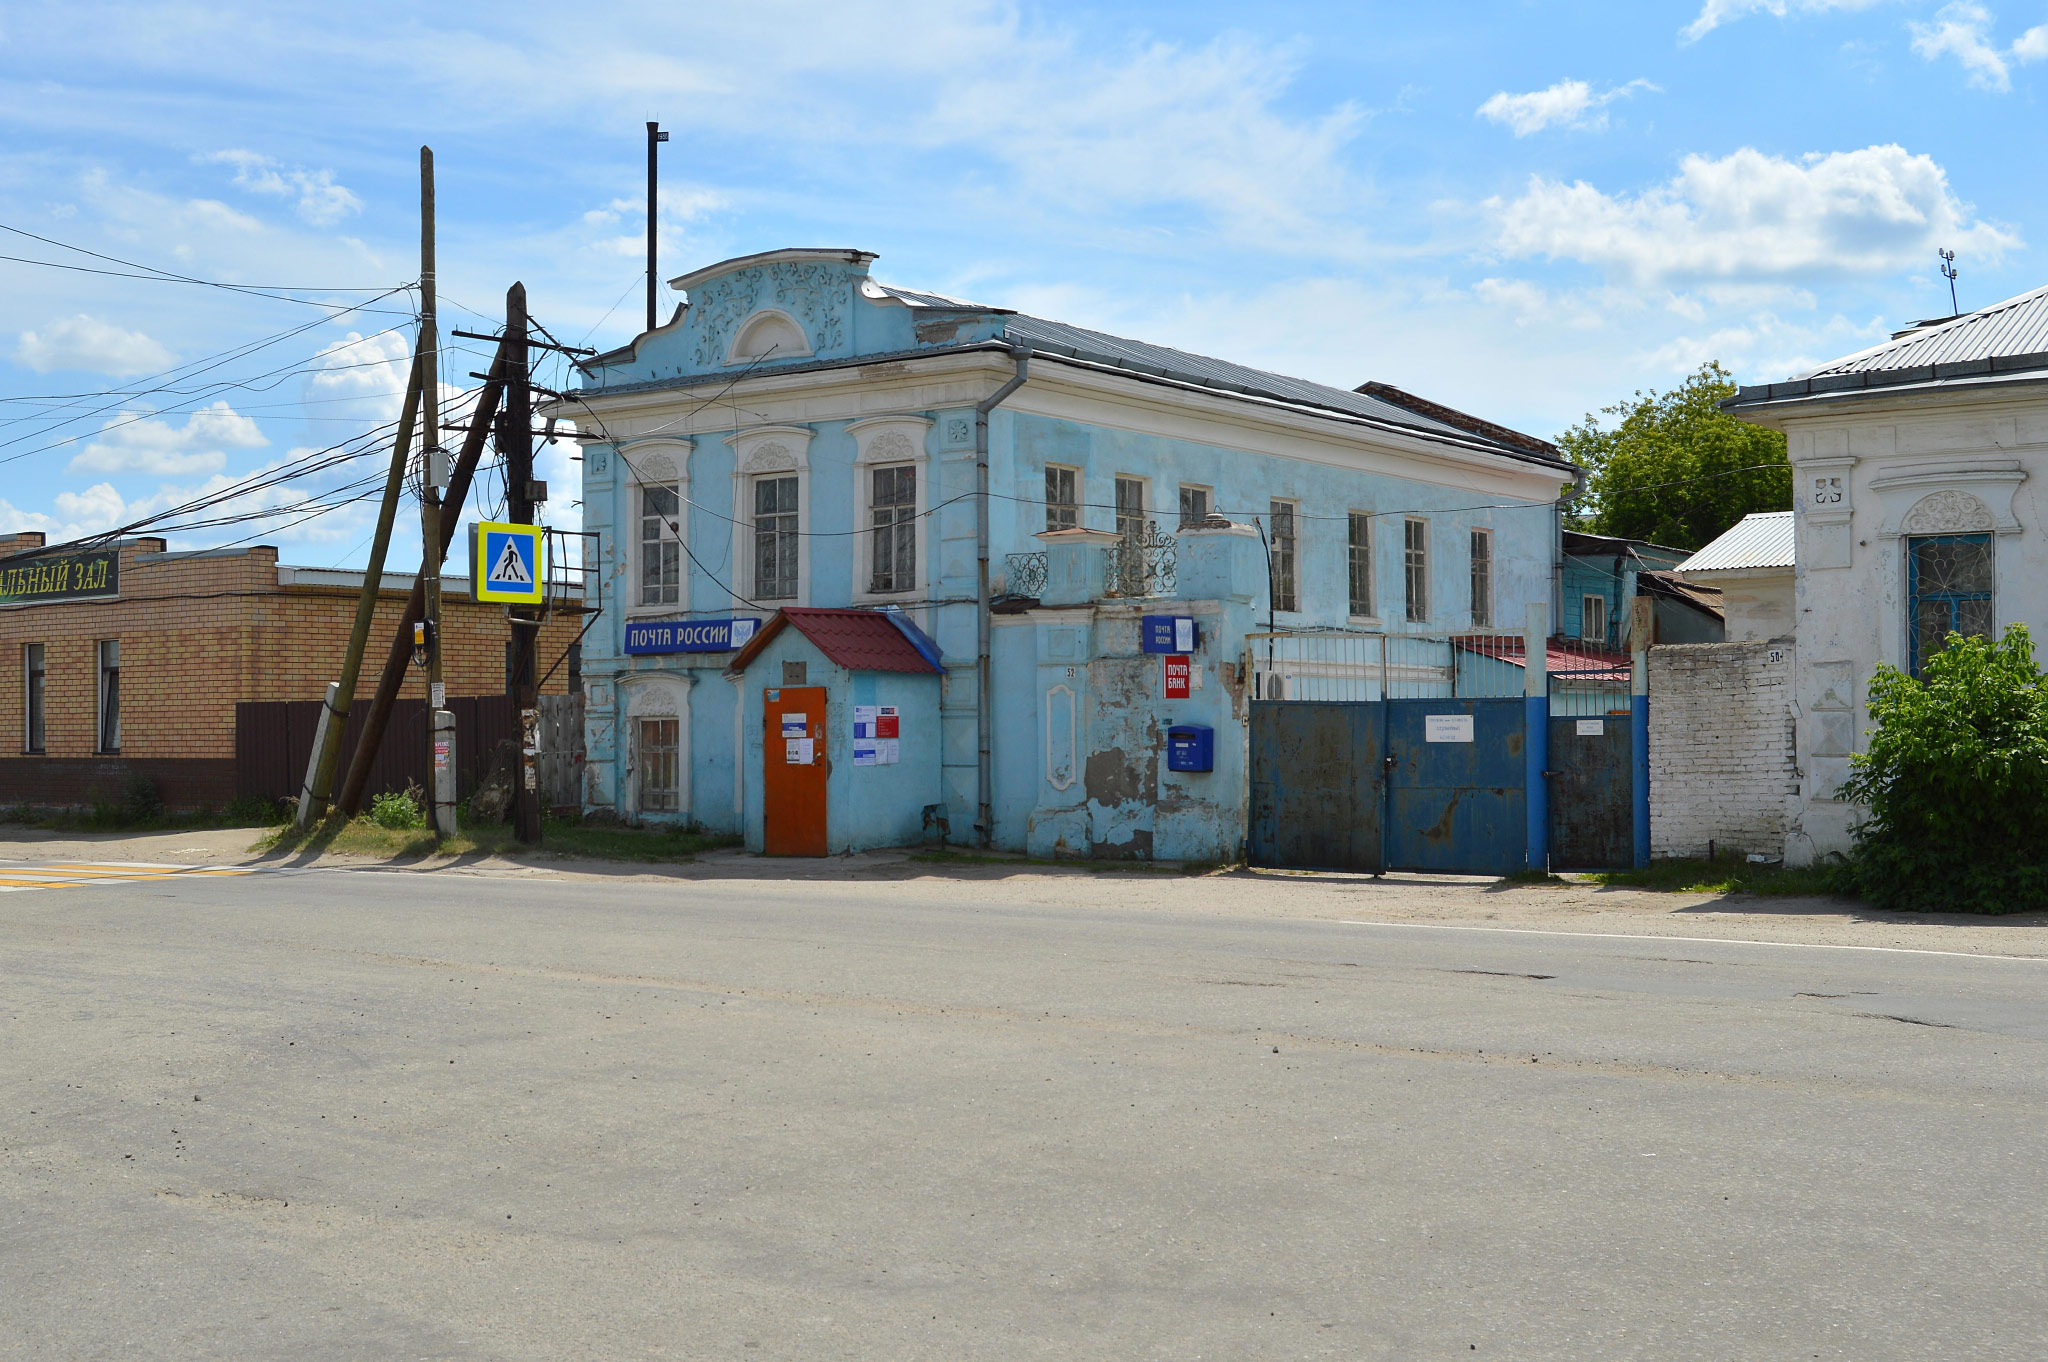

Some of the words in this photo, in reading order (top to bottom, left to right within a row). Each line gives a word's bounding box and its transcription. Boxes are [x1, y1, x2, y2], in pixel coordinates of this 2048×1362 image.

[73, 561, 108, 590] ЗАЛ
[1155, 625, 1171, 634] ПОЧТА
[630, 628, 671, 647] ПОЧТА
[677, 625, 729, 645] РОССИИ
[1155, 635, 1171, 644] РОССИИ
[1770, 651, 1780, 662] 50
[1067, 667, 1075, 678] 52
[1167, 664, 1188, 676] ПОЧТА
[1167, 677, 1186, 689] БАНК
